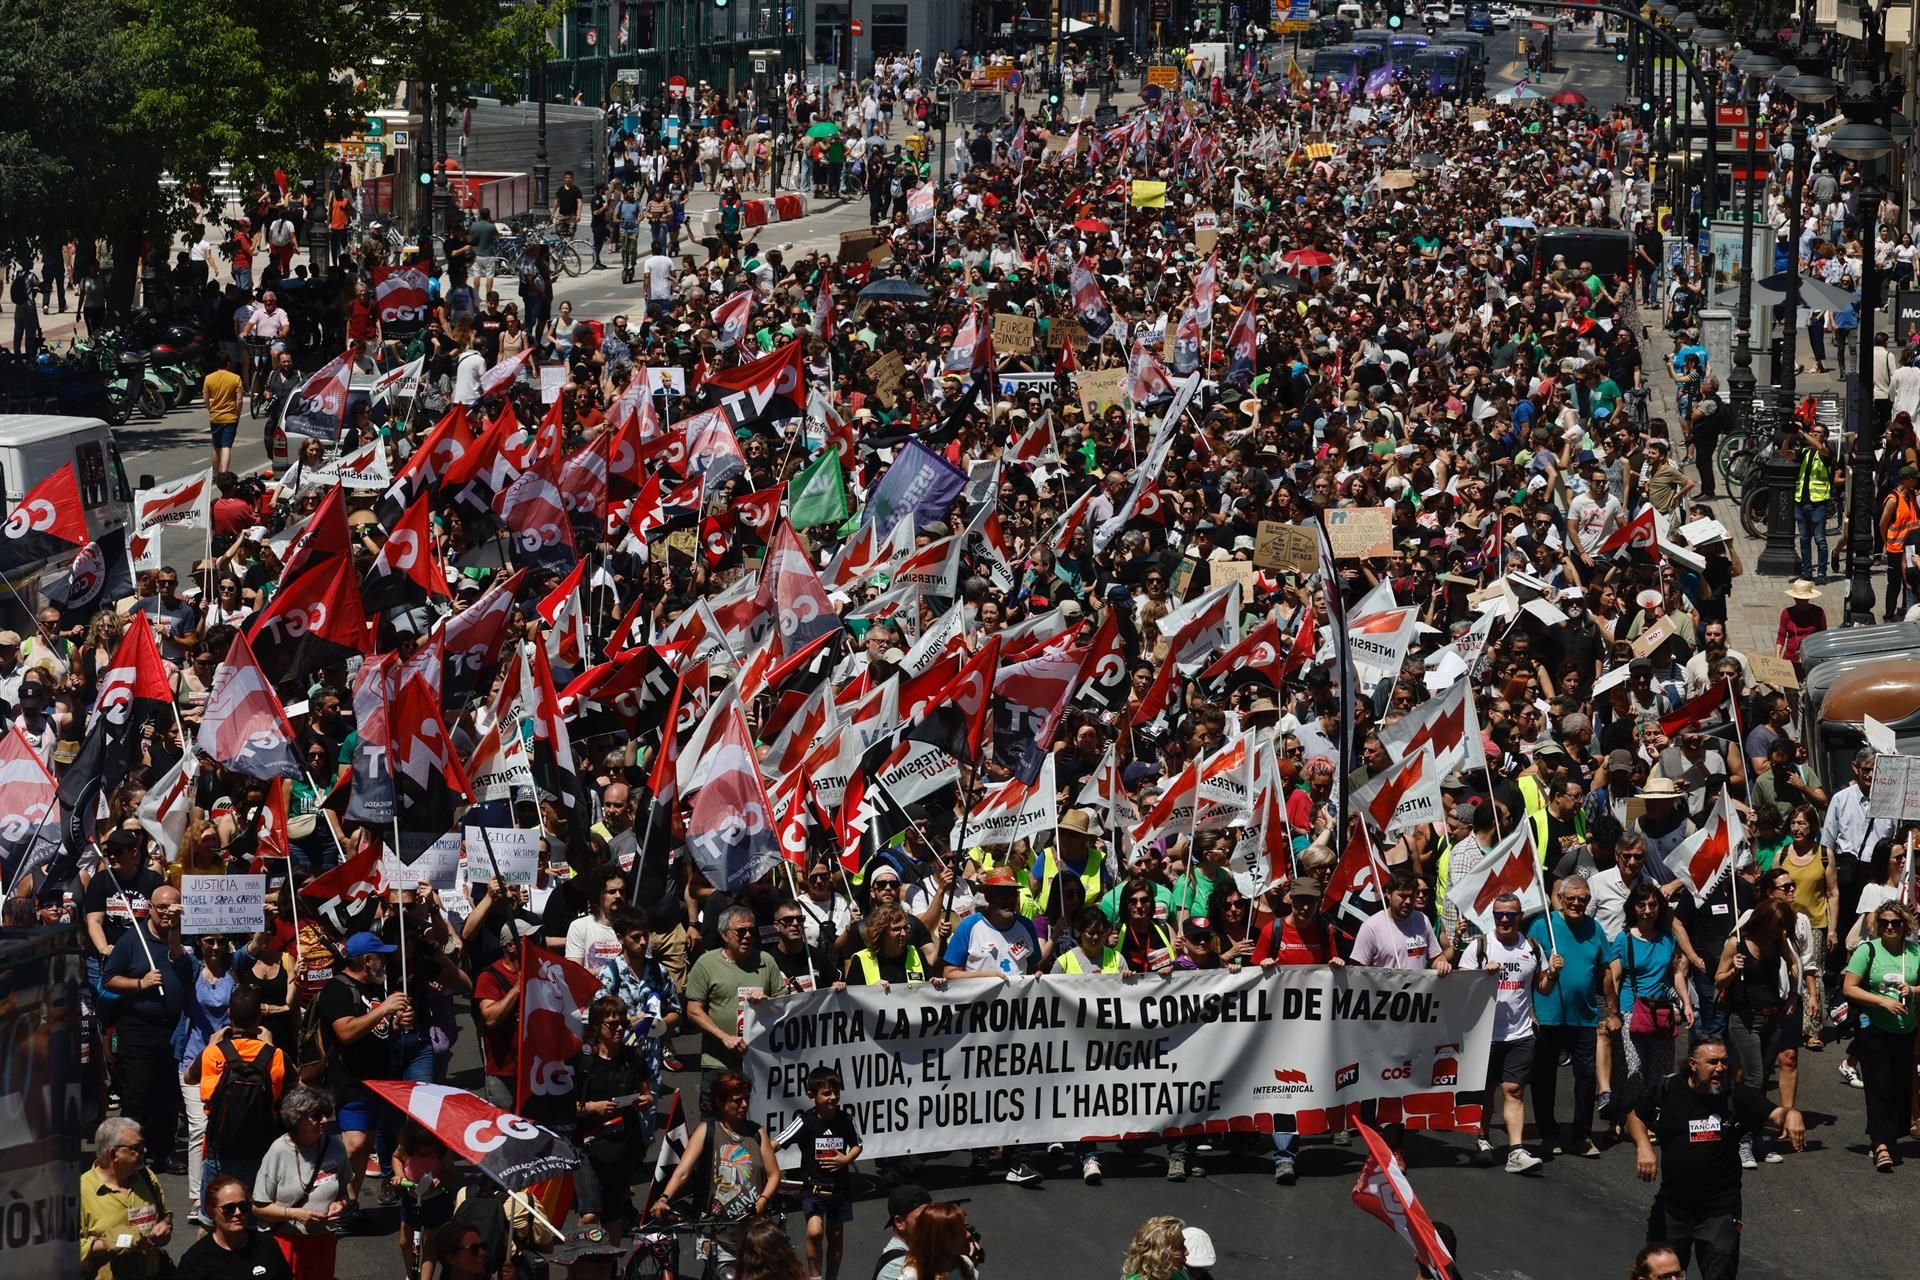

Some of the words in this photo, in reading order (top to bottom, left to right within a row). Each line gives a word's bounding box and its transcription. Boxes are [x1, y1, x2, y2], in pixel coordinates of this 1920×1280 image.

[381, 304, 428, 323] CGT
[995, 333, 1032, 347] SINDICAT
[476, 831, 526, 843] JSTICIA
[191, 879, 238, 890] JUSTICIA
[245, 881, 260, 889] PARA
[182, 895, 207, 904] MIGUEL
[214, 895, 234, 904] SARA
[308, 972, 332, 980] TANCAT
[769, 1009, 865, 1053] CONTRA
[874, 1008, 909, 1040] LA
[919, 997, 1065, 1038] PATRONAL
[1076, 998, 1087, 1021] I
[1096, 997, 1131, 1030] EL
[1139, 989, 1272, 1030] CONSELL
[1282, 988, 1322, 1021] DE
[1332, 983, 1440, 1024] MAZÓN:
[767, 1062, 809, 1100] PER
[851, 1051, 912, 1089] VIDA,
[922, 1048, 951, 1083] EL
[961, 1040, 1075, 1079] TREBALL
[1086, 1037, 1177, 1073] DIGNE,
[1338, 1069, 1356, 1084] CNT
[1433, 1075, 1456, 1086] CGT
[1253, 1084, 1314, 1095] INTERSINDICAL
[918, 1083, 1025, 1129] PÚBLICS
[1035, 1087, 1042, 1119] I
[1053, 1080, 1223, 1119] L'HABITATGE
[464, 1113, 560, 1153] CGT
[1690, 1123, 1720, 1131] TANCAT
